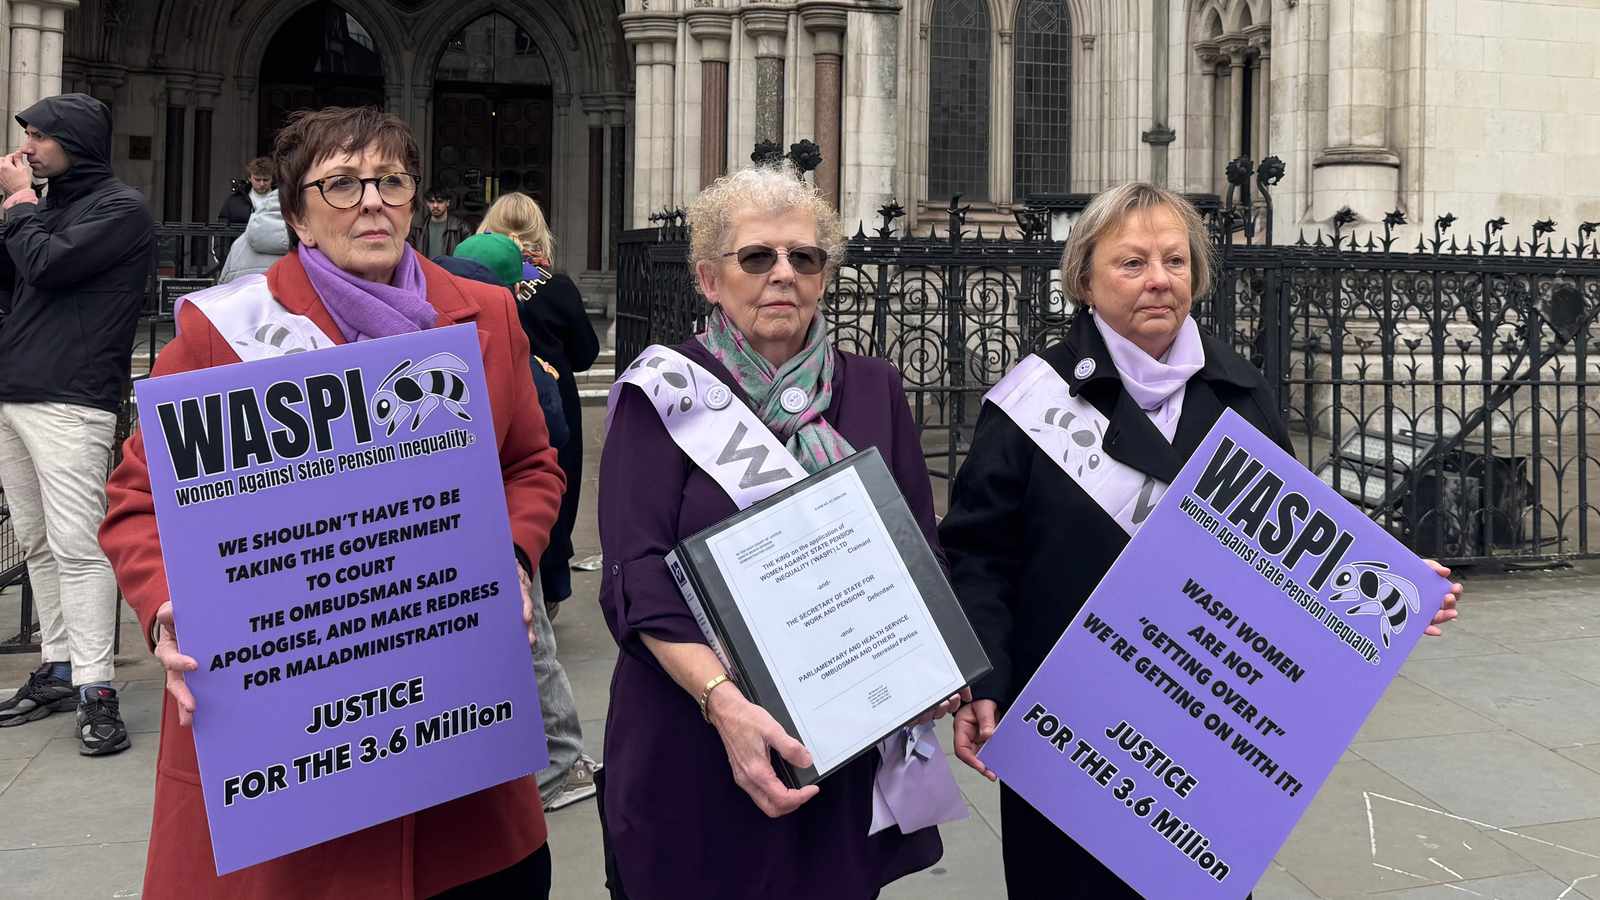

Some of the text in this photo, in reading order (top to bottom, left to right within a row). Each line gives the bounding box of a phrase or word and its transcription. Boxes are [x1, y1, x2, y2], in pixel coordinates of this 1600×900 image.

[158, 369, 372, 480] WASPI
[176, 480, 234, 506] Women
[239, 465, 295, 493] Against
[298, 458, 334, 480] State
[338, 446, 395, 471] Pension
[218, 537, 248, 558] WE
[362, 500, 409, 525] HAVE
[412, 494, 435, 512] TO
[440, 488, 460, 507] BE
[1194, 437, 1354, 591] WASPI
[225, 513, 461, 584] TAKING THE GOVERNMENT
[306, 555, 396, 591] TO COURT
[759, 528, 854, 581] WOMEN AGAINST STATE PENSION
[762, 560, 774, 569] THE
[775, 552, 790, 562] KING
[809, 528, 837, 545] application
[775, 561, 808, 582] INEQUALITY
[836, 541, 847, 550] LTD
[1180, 496, 1219, 534] Women
[1216, 527, 1259, 565] Against
[1256, 558, 1284, 586] State
[1282, 579, 1326, 620] Pension
[209, 581, 500, 672] APOLOGISE, AND MAKE REDRESS
[249, 567, 457, 633] THE OMBUDSMAN SAID
[786, 574, 874, 627] THE SECRETARY OF STATE FOR
[803, 590, 864, 627] WORK AND PENSIONS
[1182, 578, 1305, 683] WASPI WOMEN
[244, 612, 479, 690] FOR MALADMINISTRATION
[798, 614, 908, 682] PARLIAMENTARY AND HEALTH SERVICE
[821, 632, 895, 679] OMBUDSMAN AND OTHERS
[871, 630, 917, 659] Interested Parties
[1187, 626, 1263, 685] ARE NOT
[306, 678, 423, 733] JUSTICE
[1135, 657, 1205, 719] GETTING
[1204, 713, 1234, 742] ON
[1231, 733, 1279, 778] WITH
[1274, 770, 1303, 797] IT!
[1211, 680, 1258, 723] OVER
[225, 702, 512, 805] FOR THE 3.6 Million
[1106, 721, 1197, 798] JUSTICE
[1023, 704, 1229, 881] FOR THE 3.6 Million
